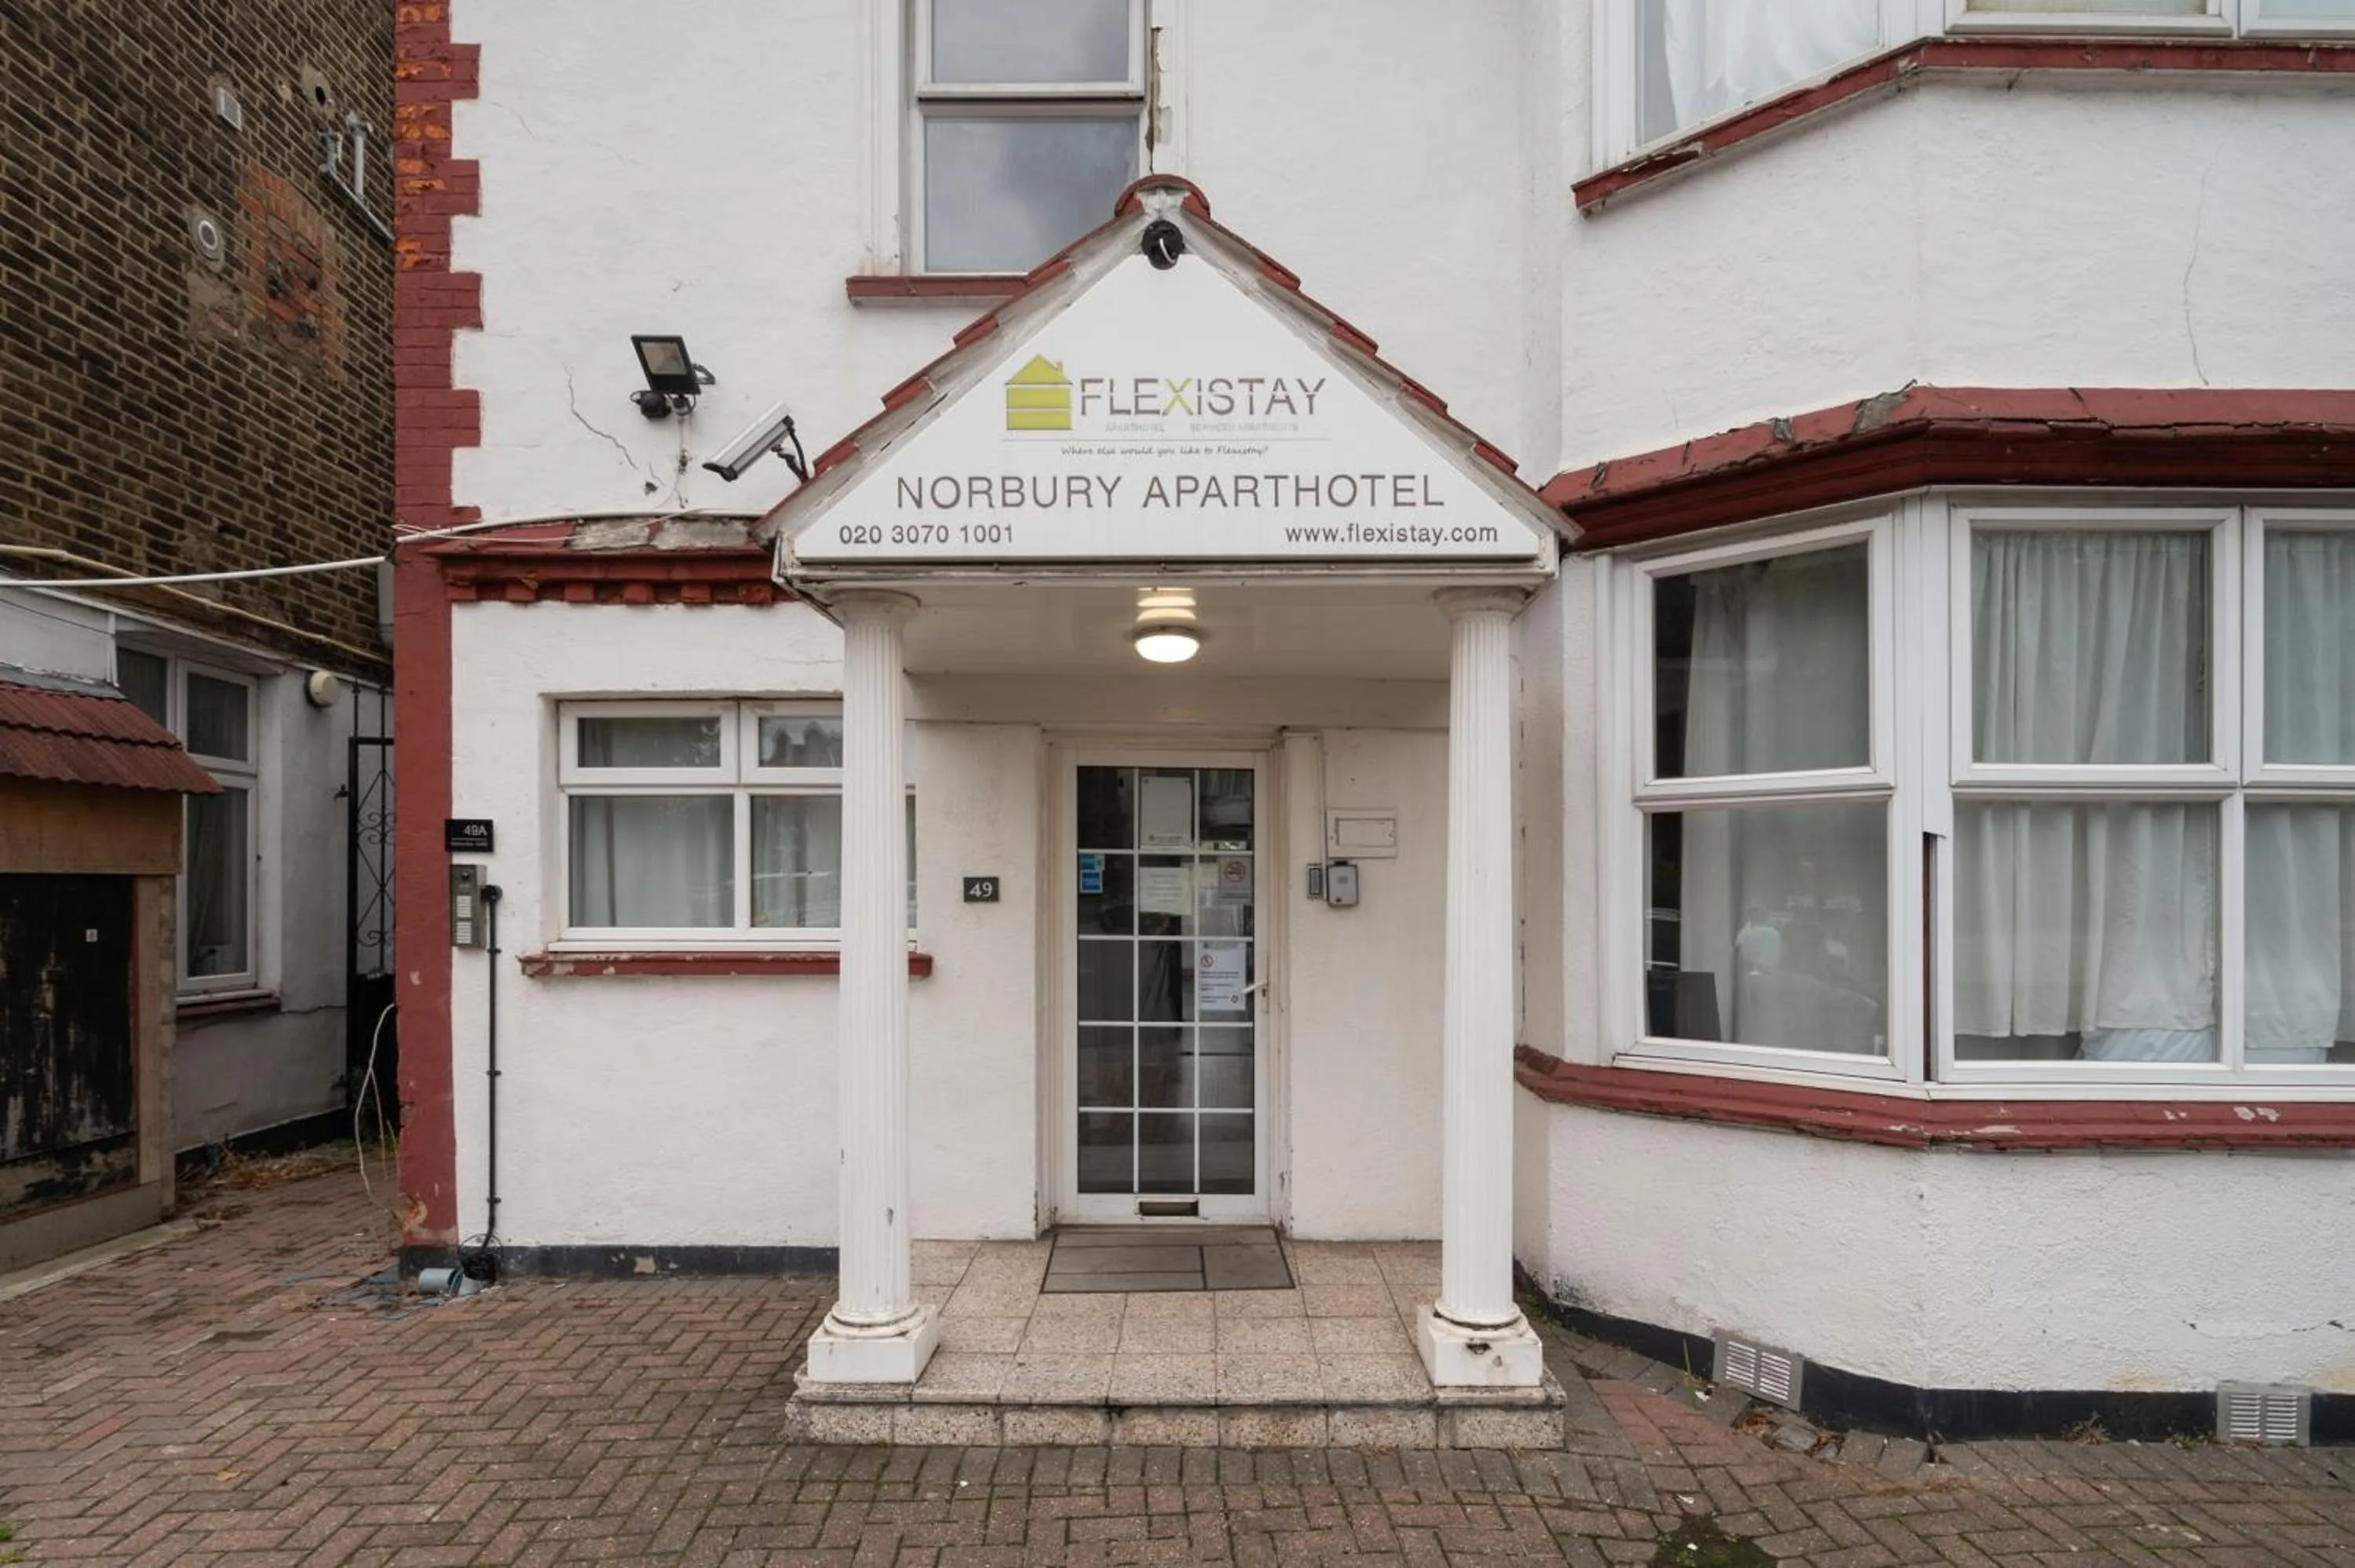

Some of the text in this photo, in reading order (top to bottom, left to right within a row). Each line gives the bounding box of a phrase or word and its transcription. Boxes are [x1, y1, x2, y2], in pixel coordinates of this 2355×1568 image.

[1080, 377, 1327, 417] FLEXISTAY
[1061, 446, 1094, 456] Where
[1097, 447, 1116, 455] else
[1120, 446, 1154, 455] would
[1157, 448, 1176, 458] you
[1180, 446, 1201, 455] like
[1203, 447, 1214, 455] to
[897, 474, 1445, 509] NORBURY APARTHOTEL
[839, 524, 1013, 545] 020 3070 1001
[1285, 523, 1499, 547] www.flexistay.com
[464, 824, 487, 836] 49A
[969, 881, 993, 898] 49
